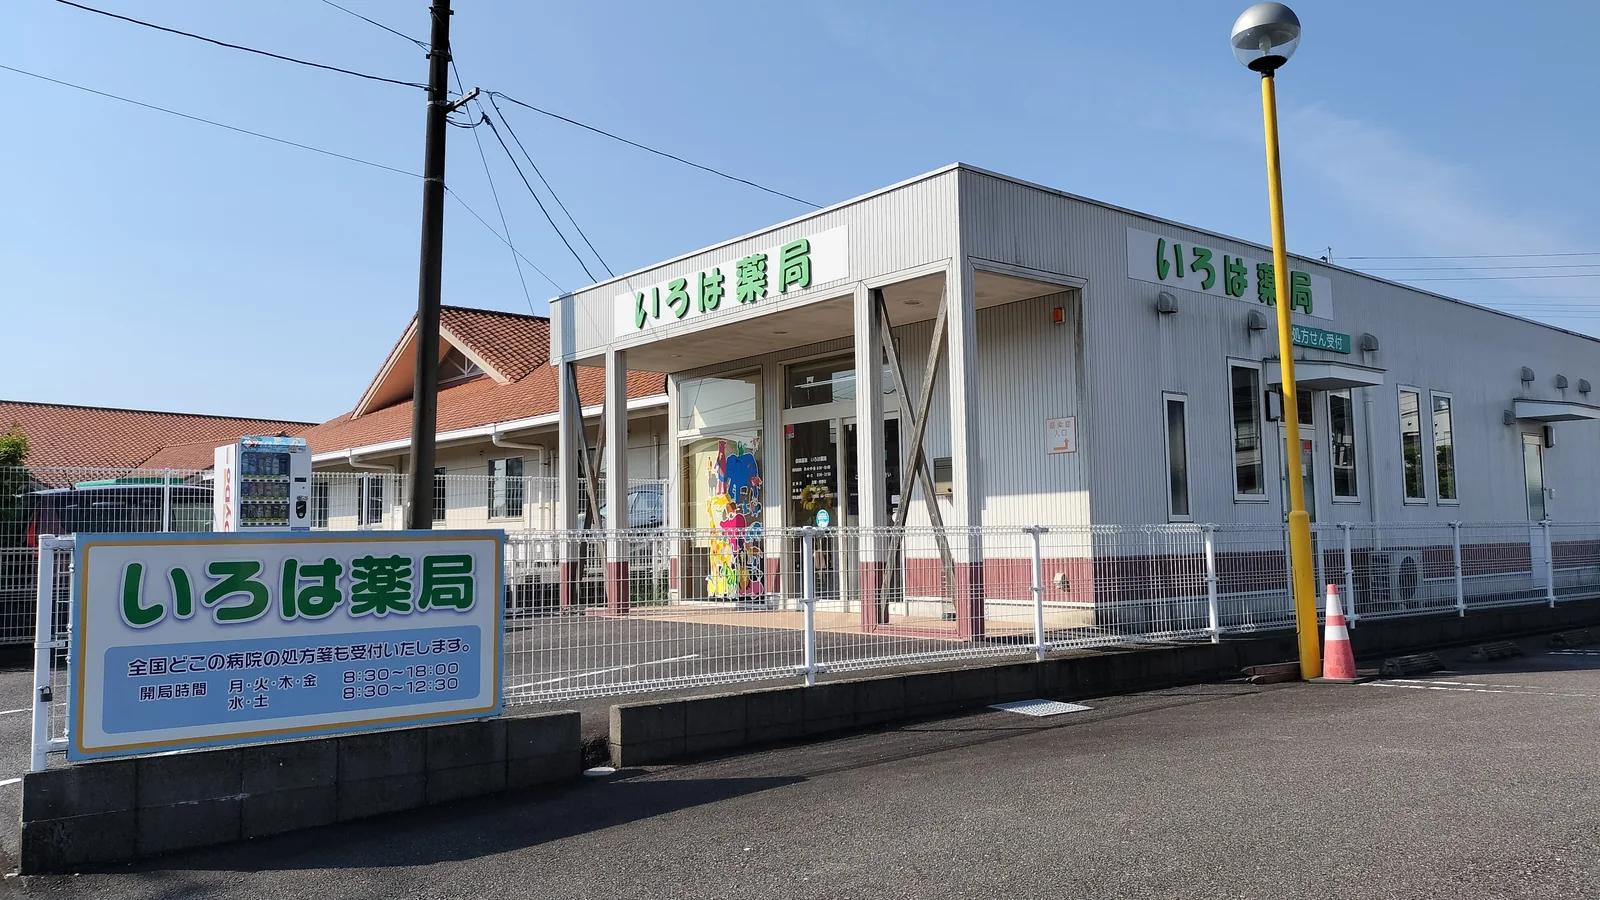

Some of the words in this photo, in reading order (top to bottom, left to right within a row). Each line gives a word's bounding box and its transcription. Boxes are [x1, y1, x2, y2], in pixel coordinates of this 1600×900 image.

[635, 238, 812, 329] いろは薬局
[1292, 326, 1343, 350] 処方せん受付
[121, 554, 475, 627] いろは薬局
[128, 638, 470, 677] 全国どこの病院の処方箋も受付いたします。
[140, 682, 207, 701] 開局時間
